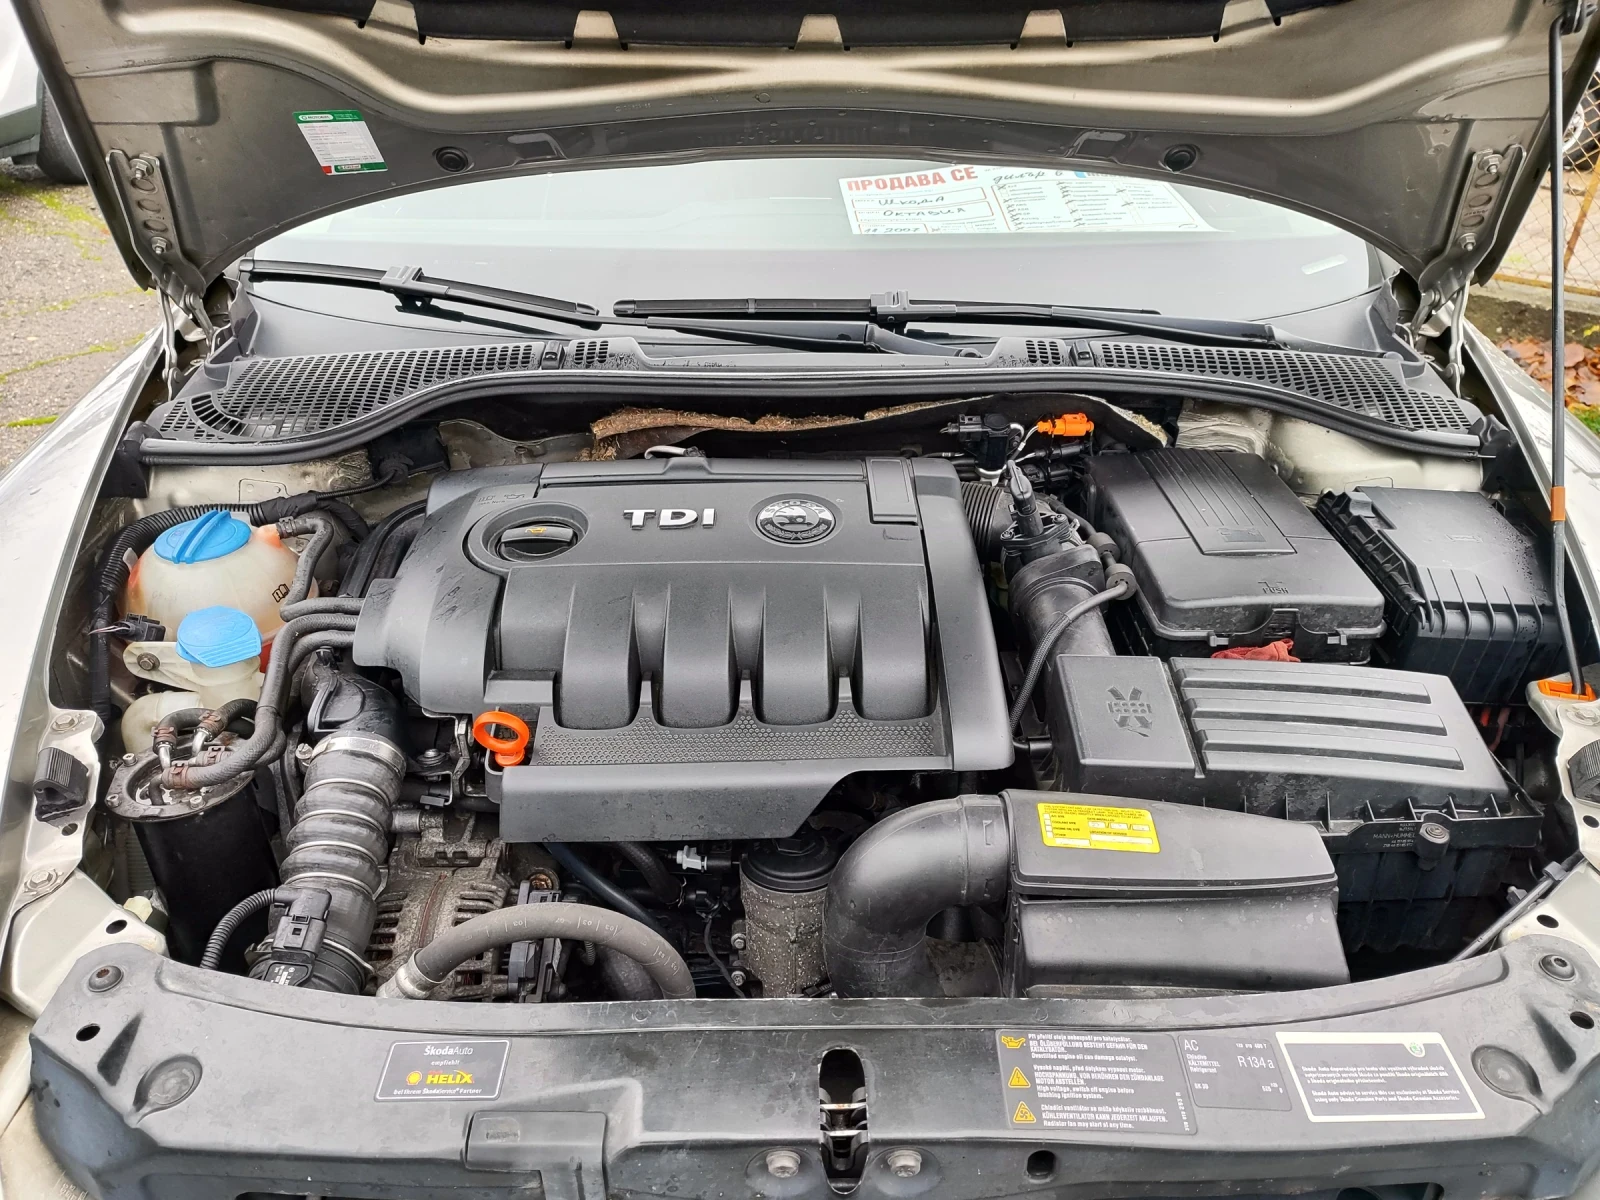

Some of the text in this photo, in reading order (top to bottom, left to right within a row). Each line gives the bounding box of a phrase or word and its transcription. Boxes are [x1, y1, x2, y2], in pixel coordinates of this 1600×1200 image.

[847, 166, 978, 191] ПРОДАВА СЕ
[623, 508, 716, 530] TDI
[1184, 1039, 1199, 1051] AC
[426, 1070, 474, 1085] HELIX
